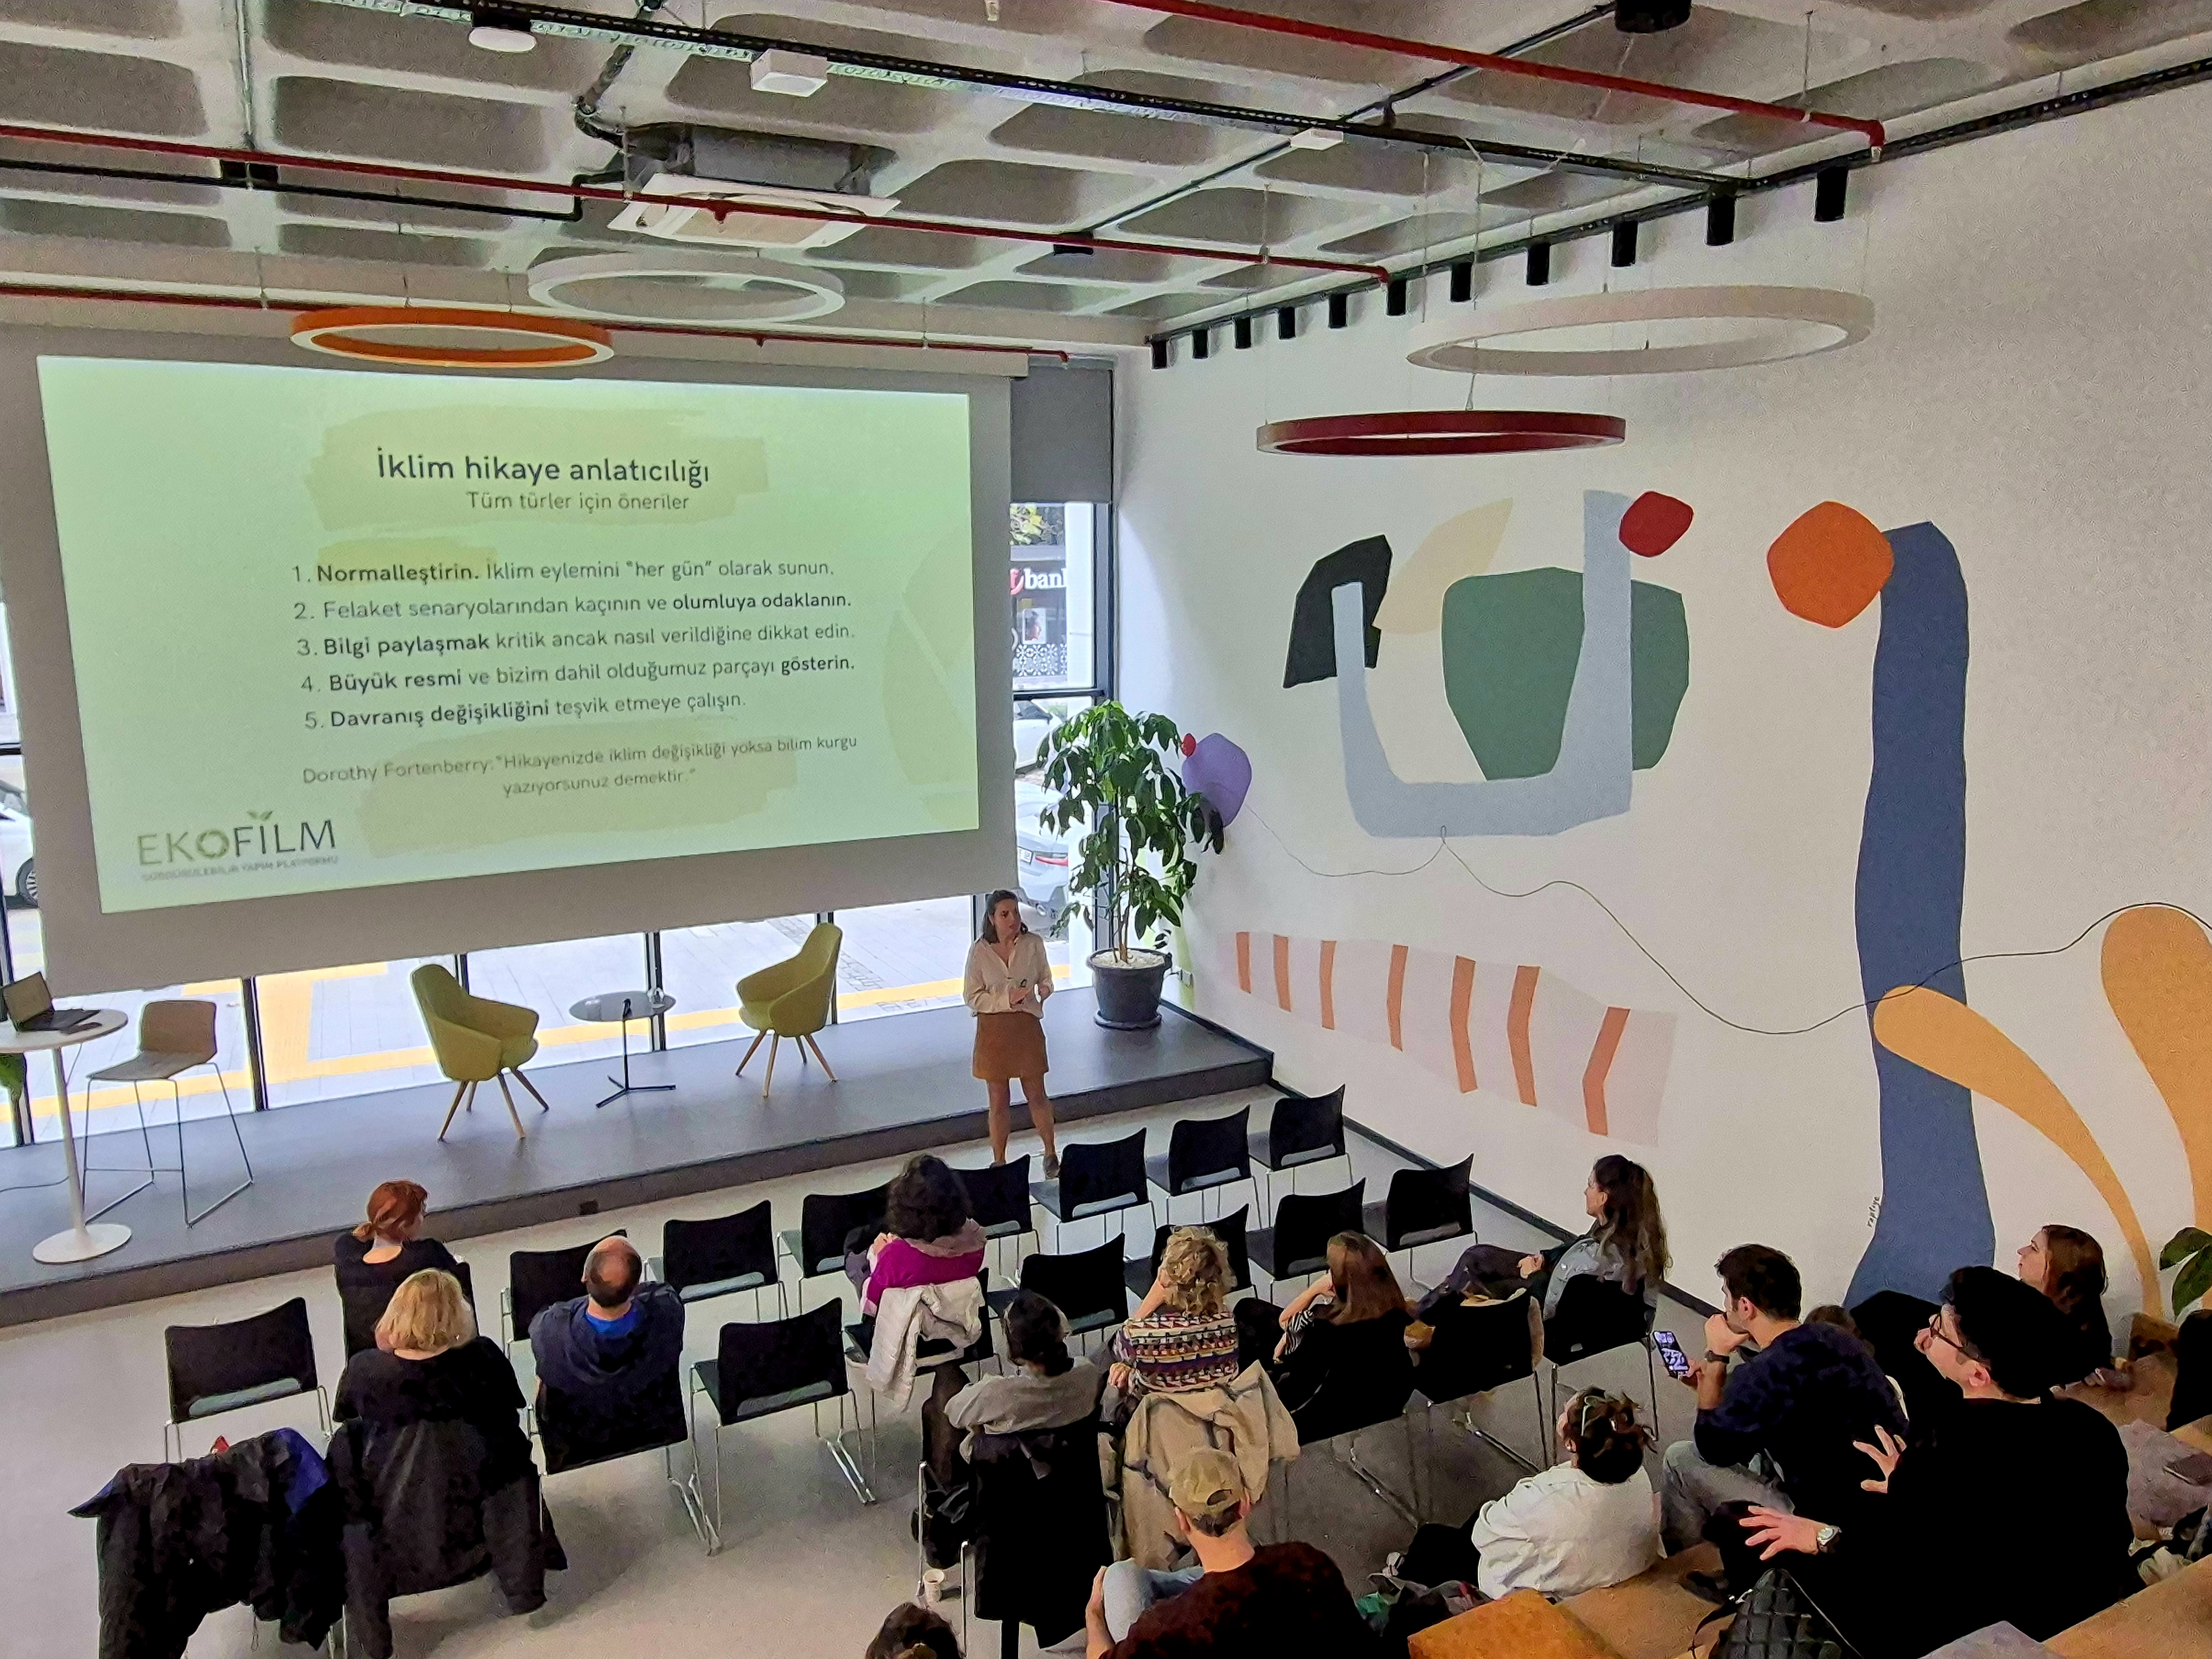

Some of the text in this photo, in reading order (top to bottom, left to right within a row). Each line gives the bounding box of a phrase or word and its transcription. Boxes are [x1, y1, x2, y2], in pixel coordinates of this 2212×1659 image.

[377, 446, 709, 489] İklim hikaye anlatıcılığı
[467, 491, 690, 514] Tüm türler için öneriler
[291, 565, 311, 583] 1.
[316, 562, 479, 586] Normalleştirin.
[486, 558, 534, 580] İklim
[540, 560, 620, 583] eylemini
[718, 559, 773, 576] olarak
[778, 562, 834, 576] sunun.
[293, 592, 852, 620] 2. Felaket senaryolarından kaçının ve olumluya odaklanın.
[296, 623, 855, 659] 3. Bilgi paylaşmak kritik ancak nasıl verildiğine dikkat edin.
[300, 654, 855, 696] 4. Büyük resmi ve bizim dahil olduğumuz parçayı gösterin.
[305, 692, 746, 730] 5. Davranış değişikliğini teşvik etmeye çalışın.
[302, 765, 378, 785] Dorothy
[731, 740, 773, 758] yoksa
[816, 736, 857, 752] kurgu
